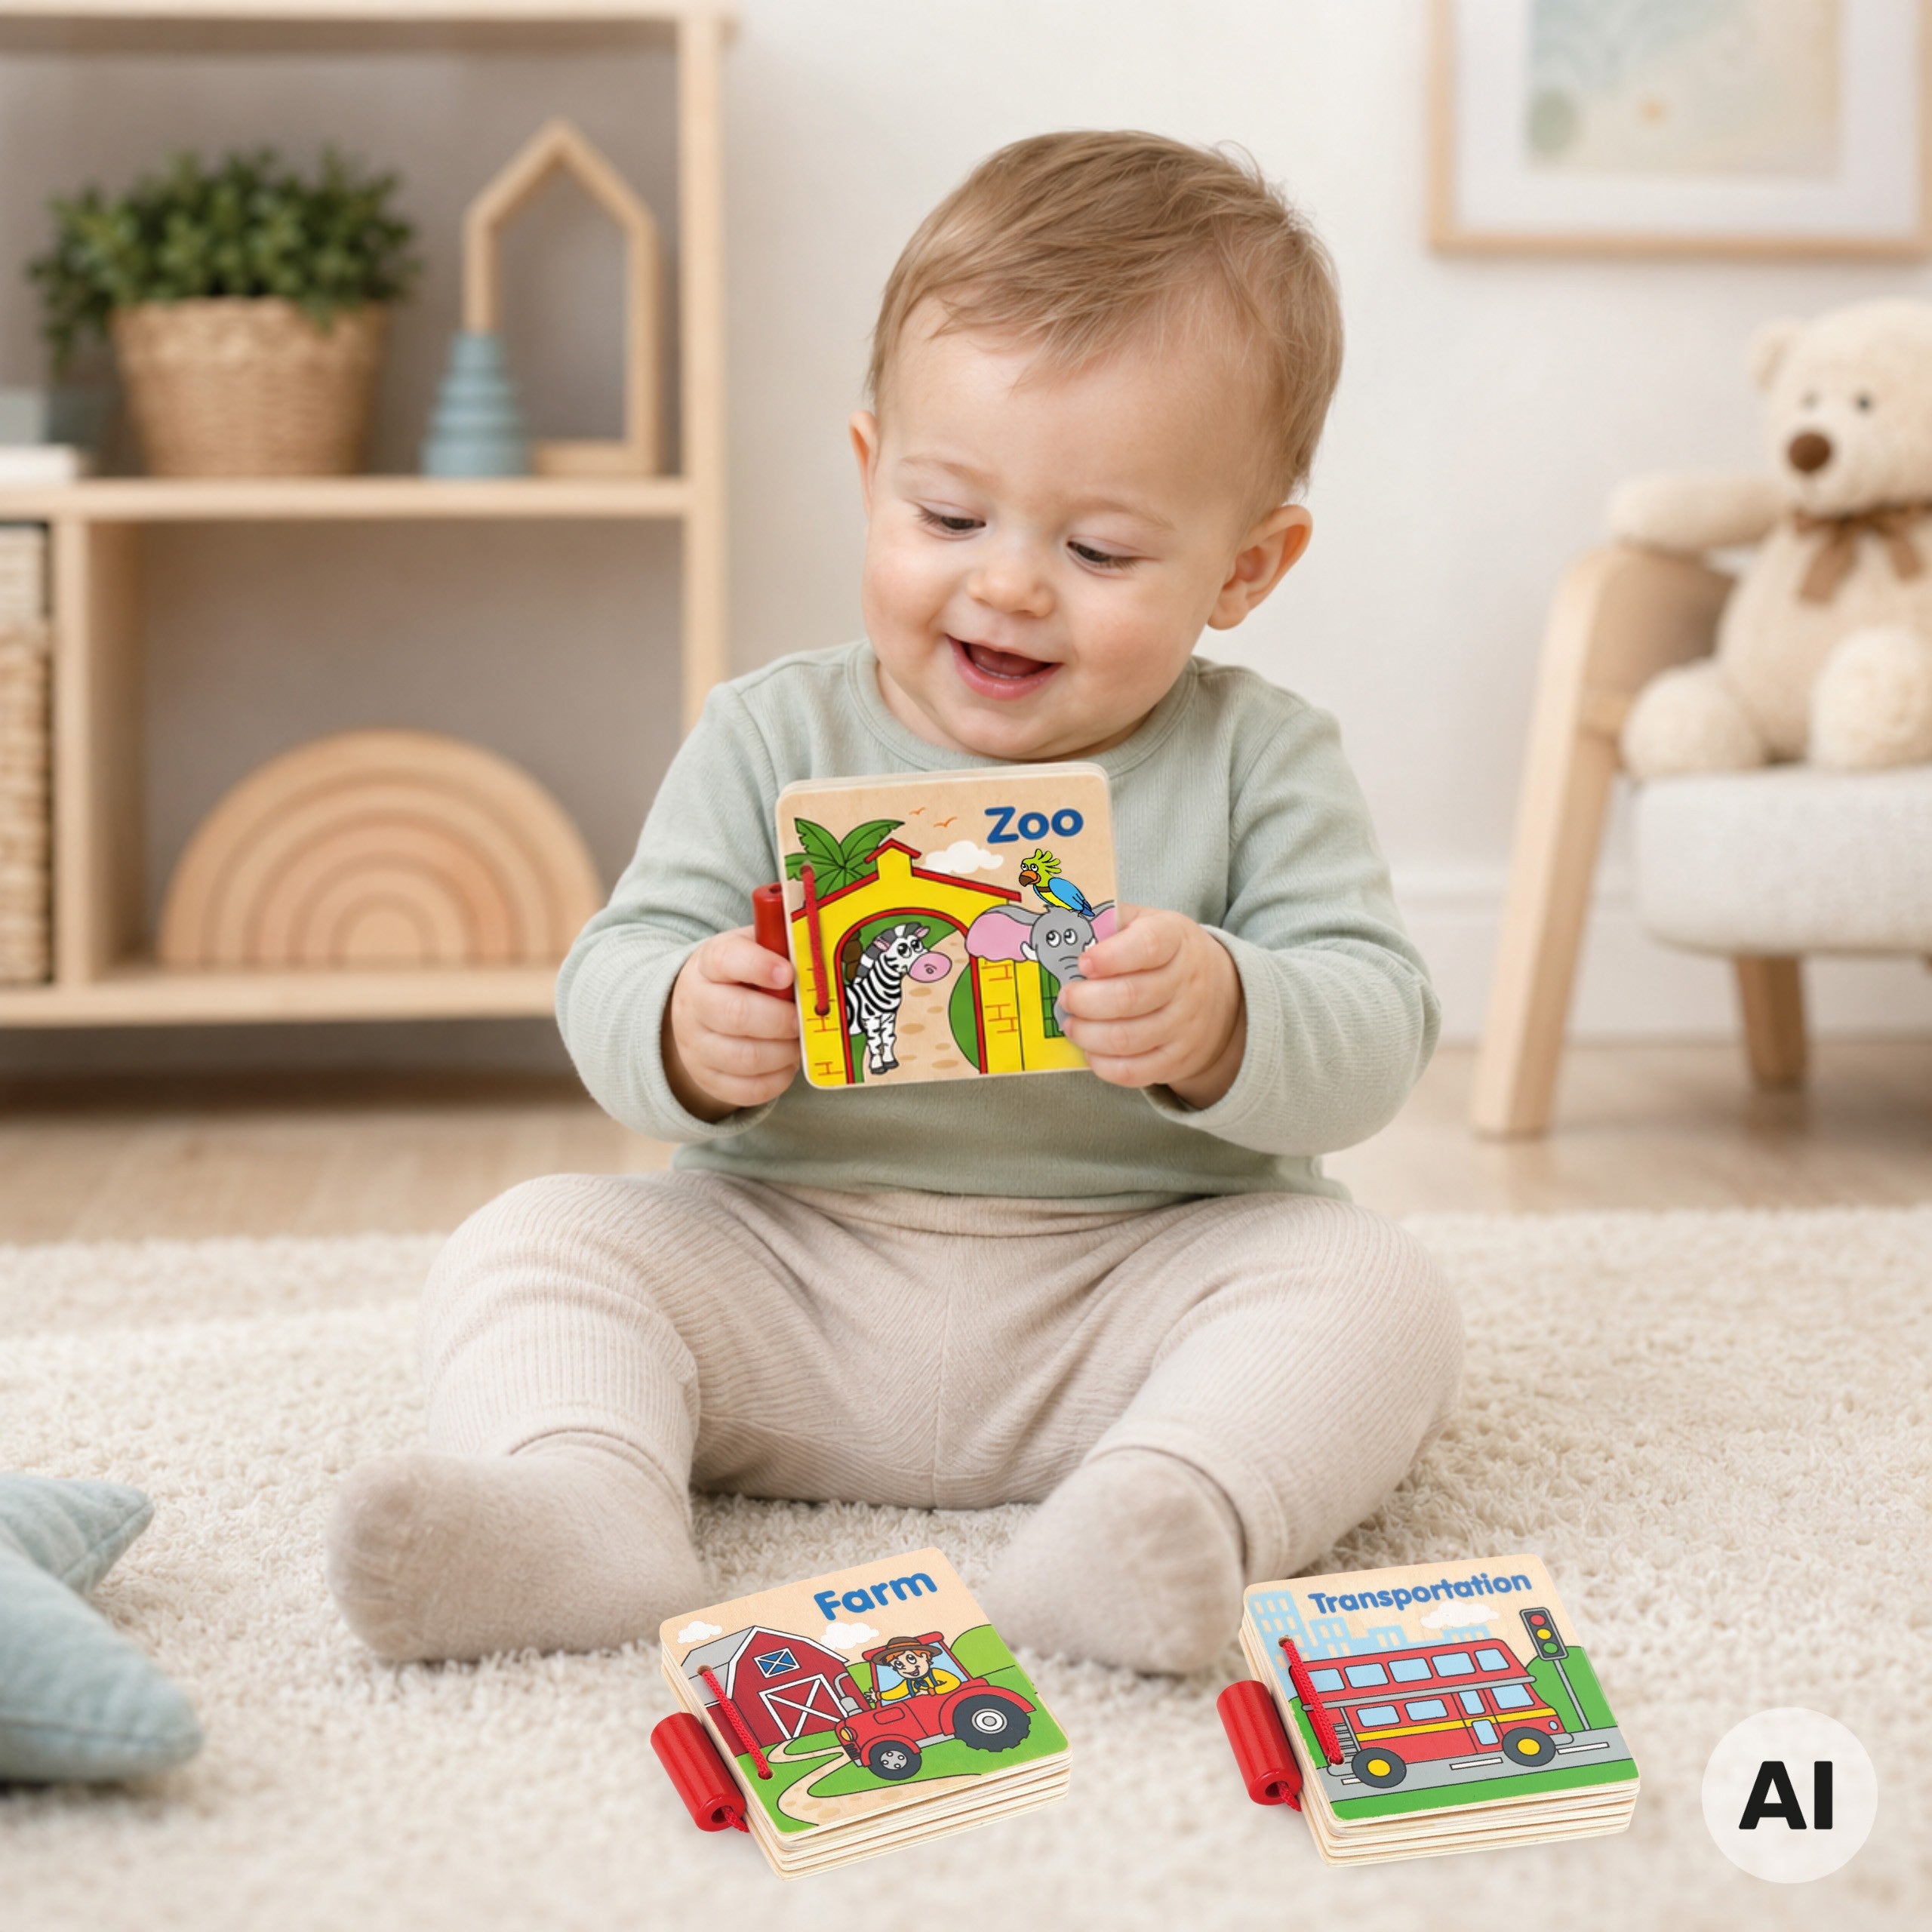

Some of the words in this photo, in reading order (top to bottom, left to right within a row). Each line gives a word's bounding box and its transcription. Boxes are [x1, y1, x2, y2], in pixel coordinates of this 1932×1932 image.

[984, 806, 1084, 843] Zoo
[814, 1572, 937, 1620] Farm
[1308, 1572, 1531, 1613] Transportation
